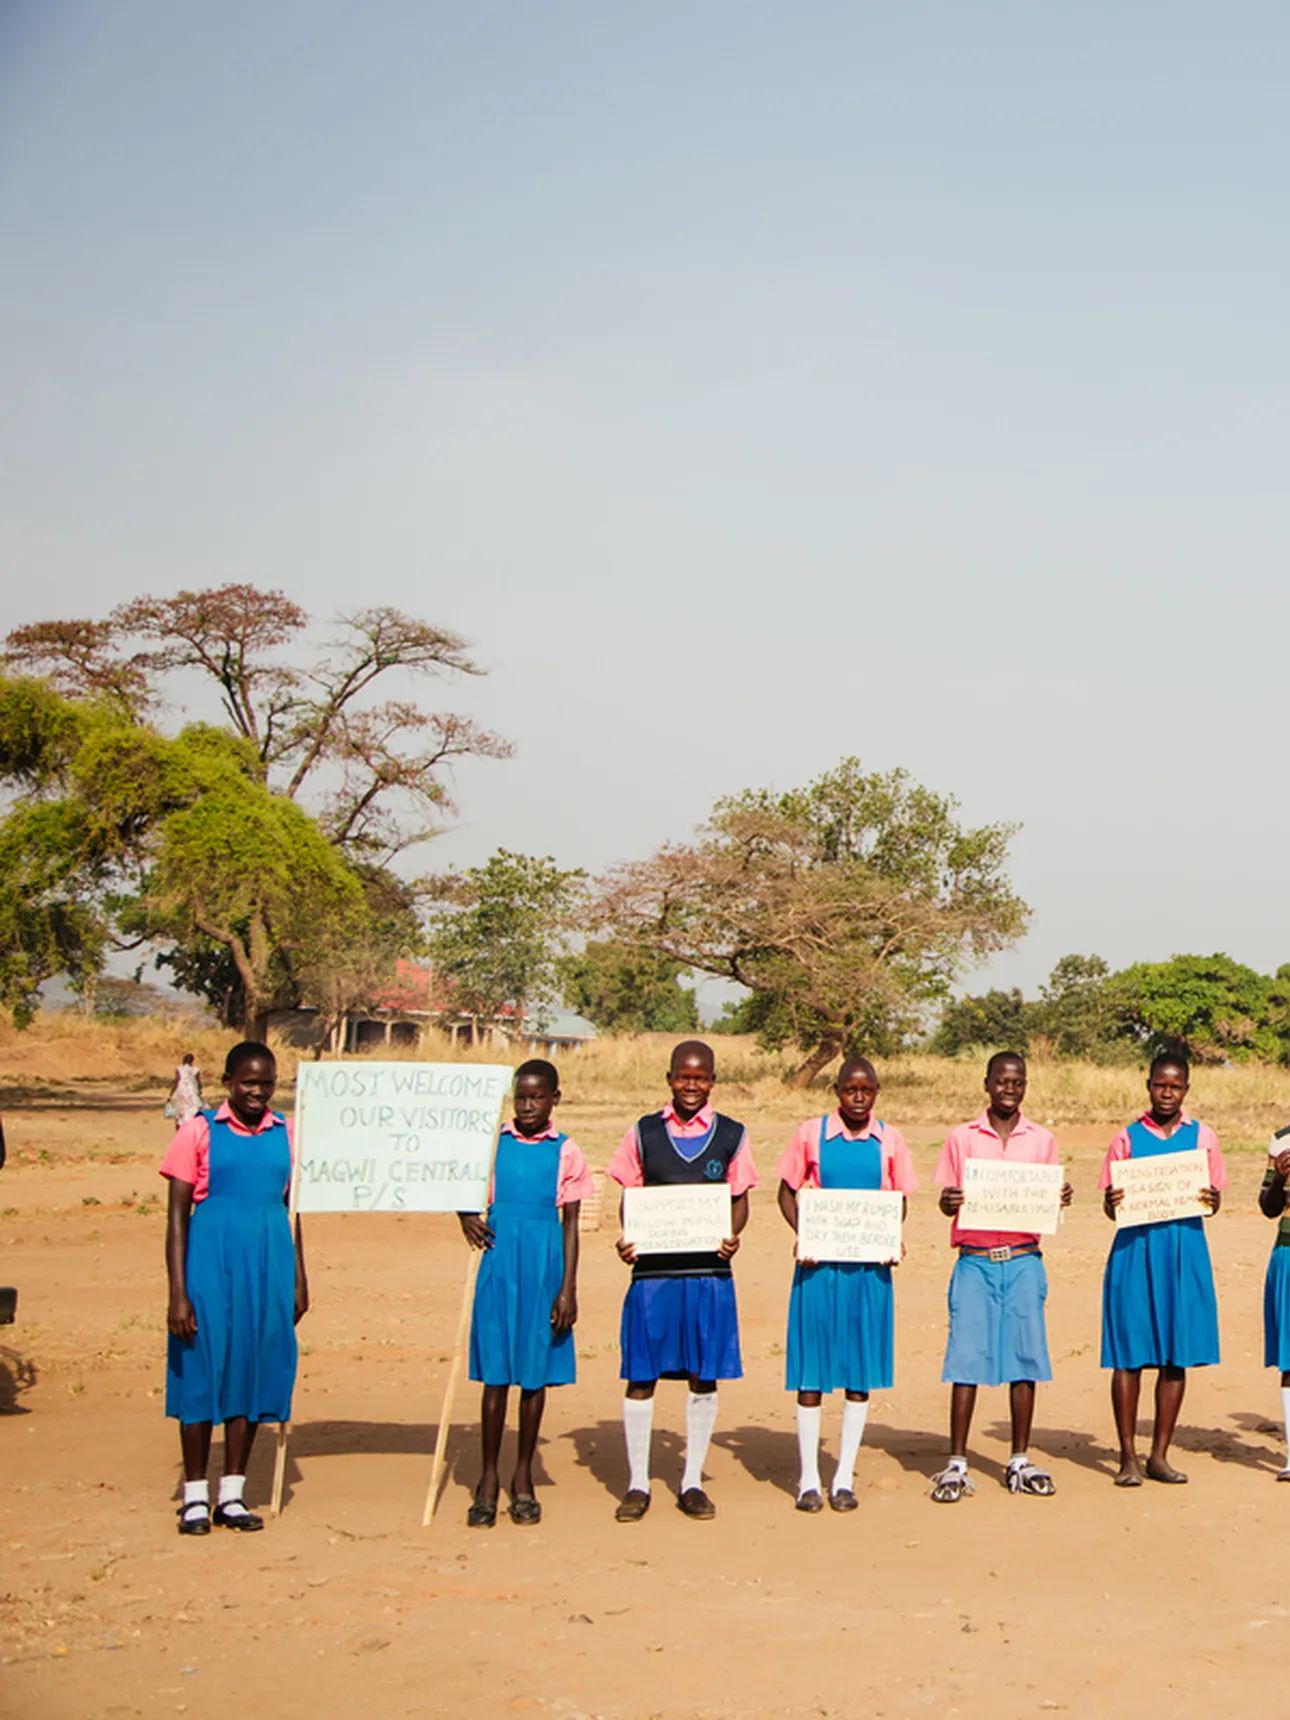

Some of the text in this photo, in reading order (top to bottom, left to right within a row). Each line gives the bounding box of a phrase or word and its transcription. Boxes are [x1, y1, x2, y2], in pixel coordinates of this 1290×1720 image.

[304, 1070, 498, 1098] MOST WELCOME
[340, 1106, 494, 1134] OUR VISITORS
[388, 1133, 421, 1152] TO
[300, 1159, 486, 1183] MAGWI CENTRAL
[353, 1183, 408, 1207] P/S
[1022, 1187, 1047, 1199] THE
